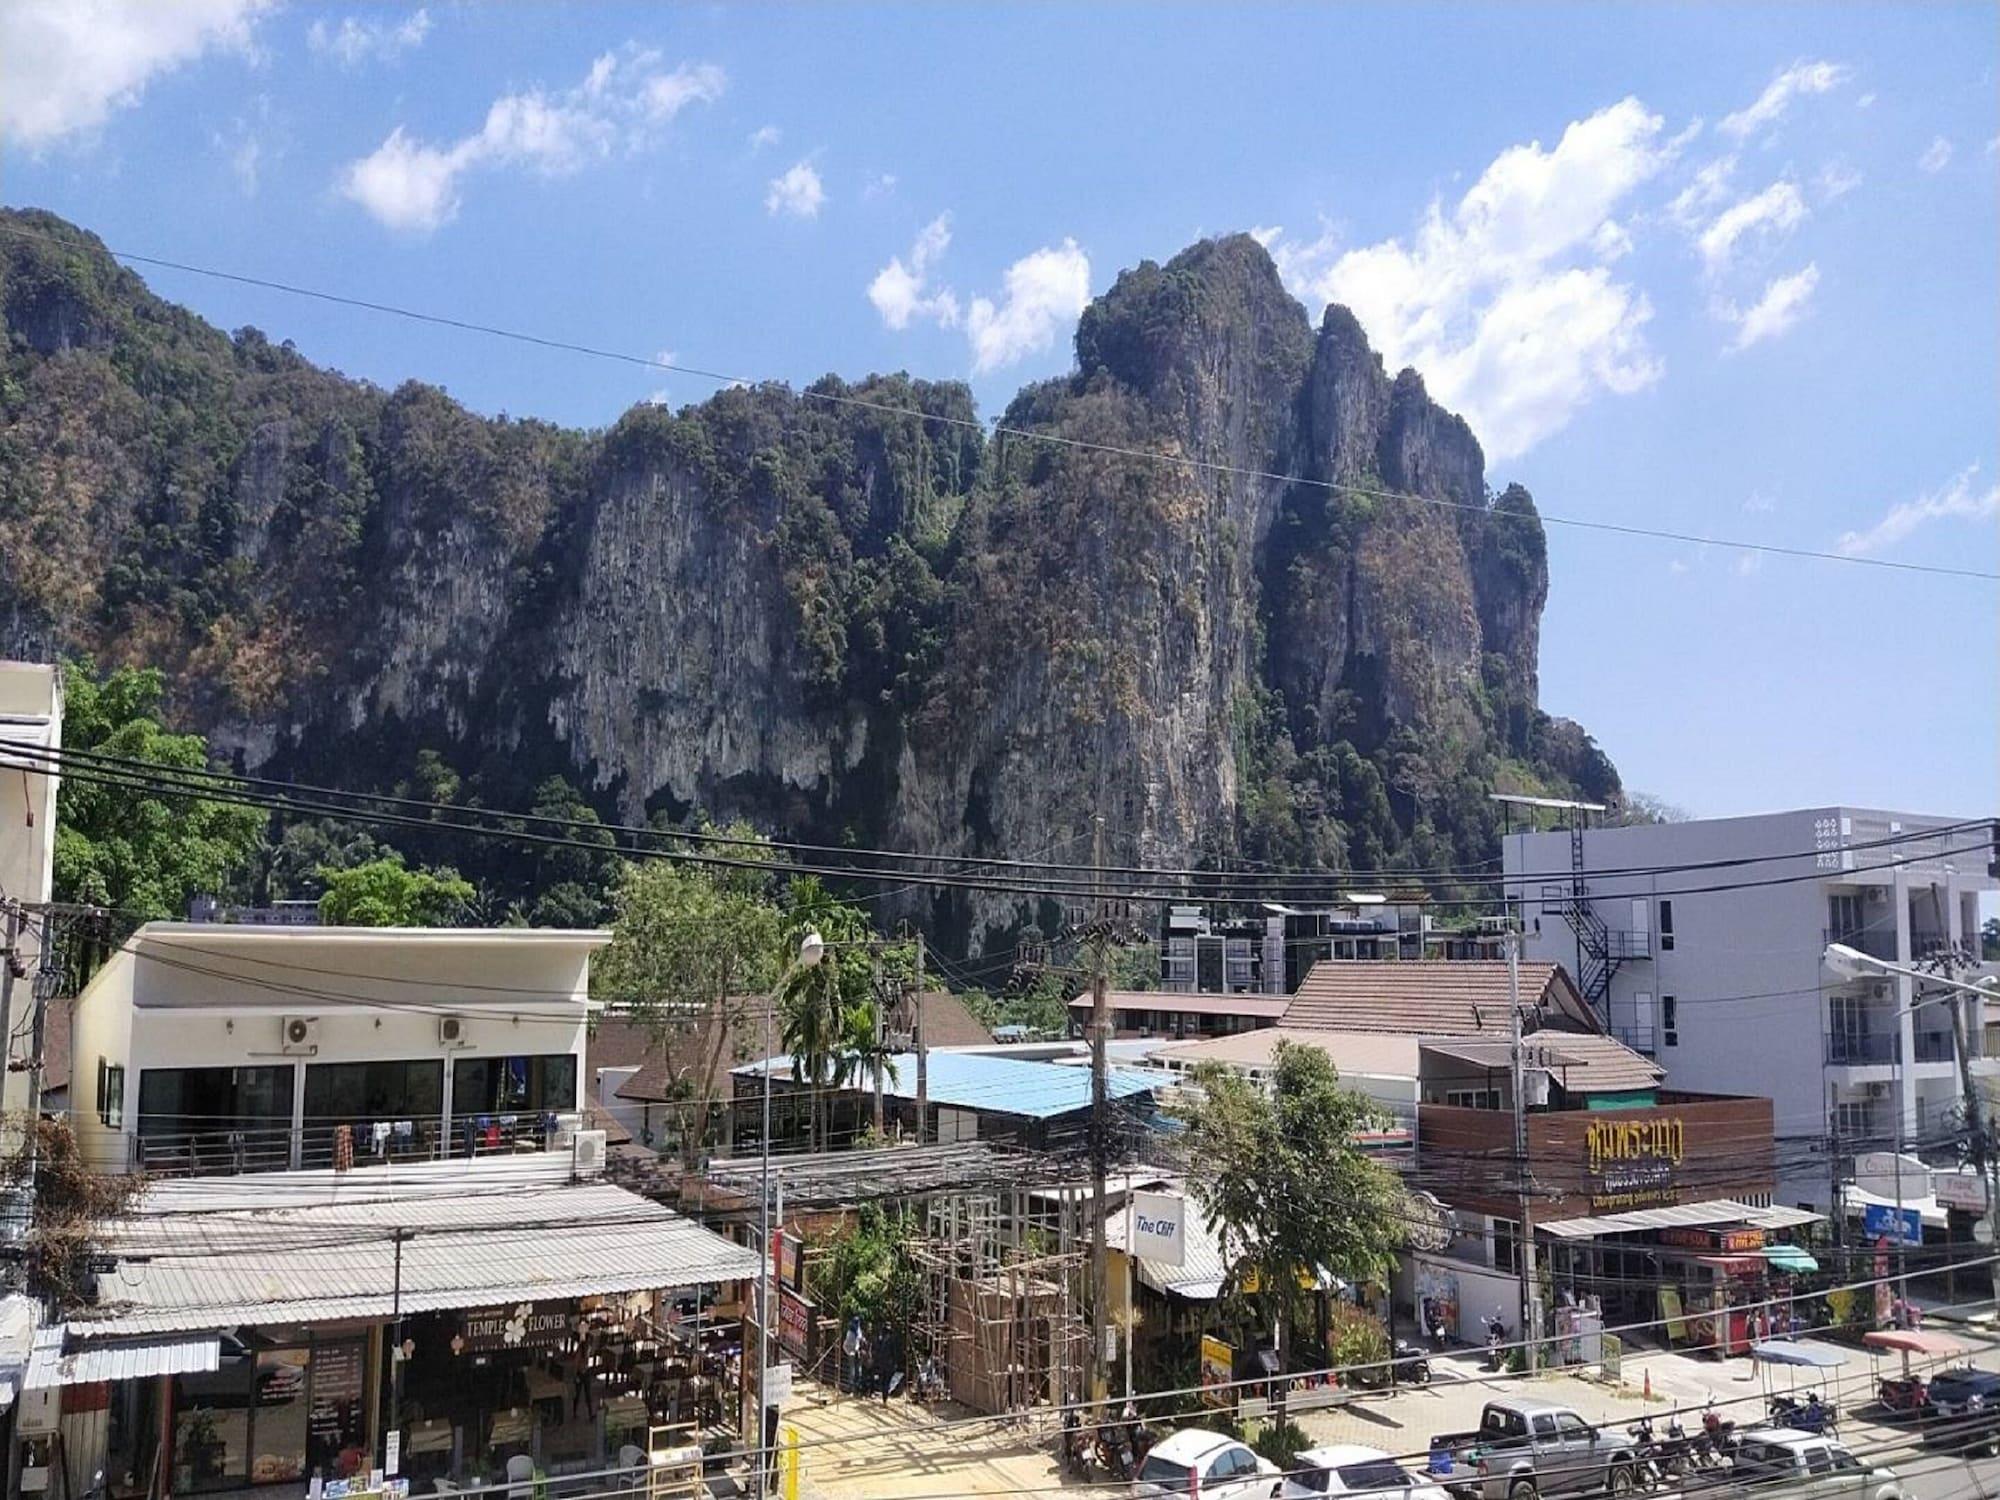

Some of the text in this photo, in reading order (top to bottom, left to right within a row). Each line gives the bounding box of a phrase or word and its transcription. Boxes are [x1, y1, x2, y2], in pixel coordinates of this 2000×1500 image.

[1137, 1216, 1176, 1238] The Cliff
[467, 1314, 566, 1337] TEMPLE FLOWER
